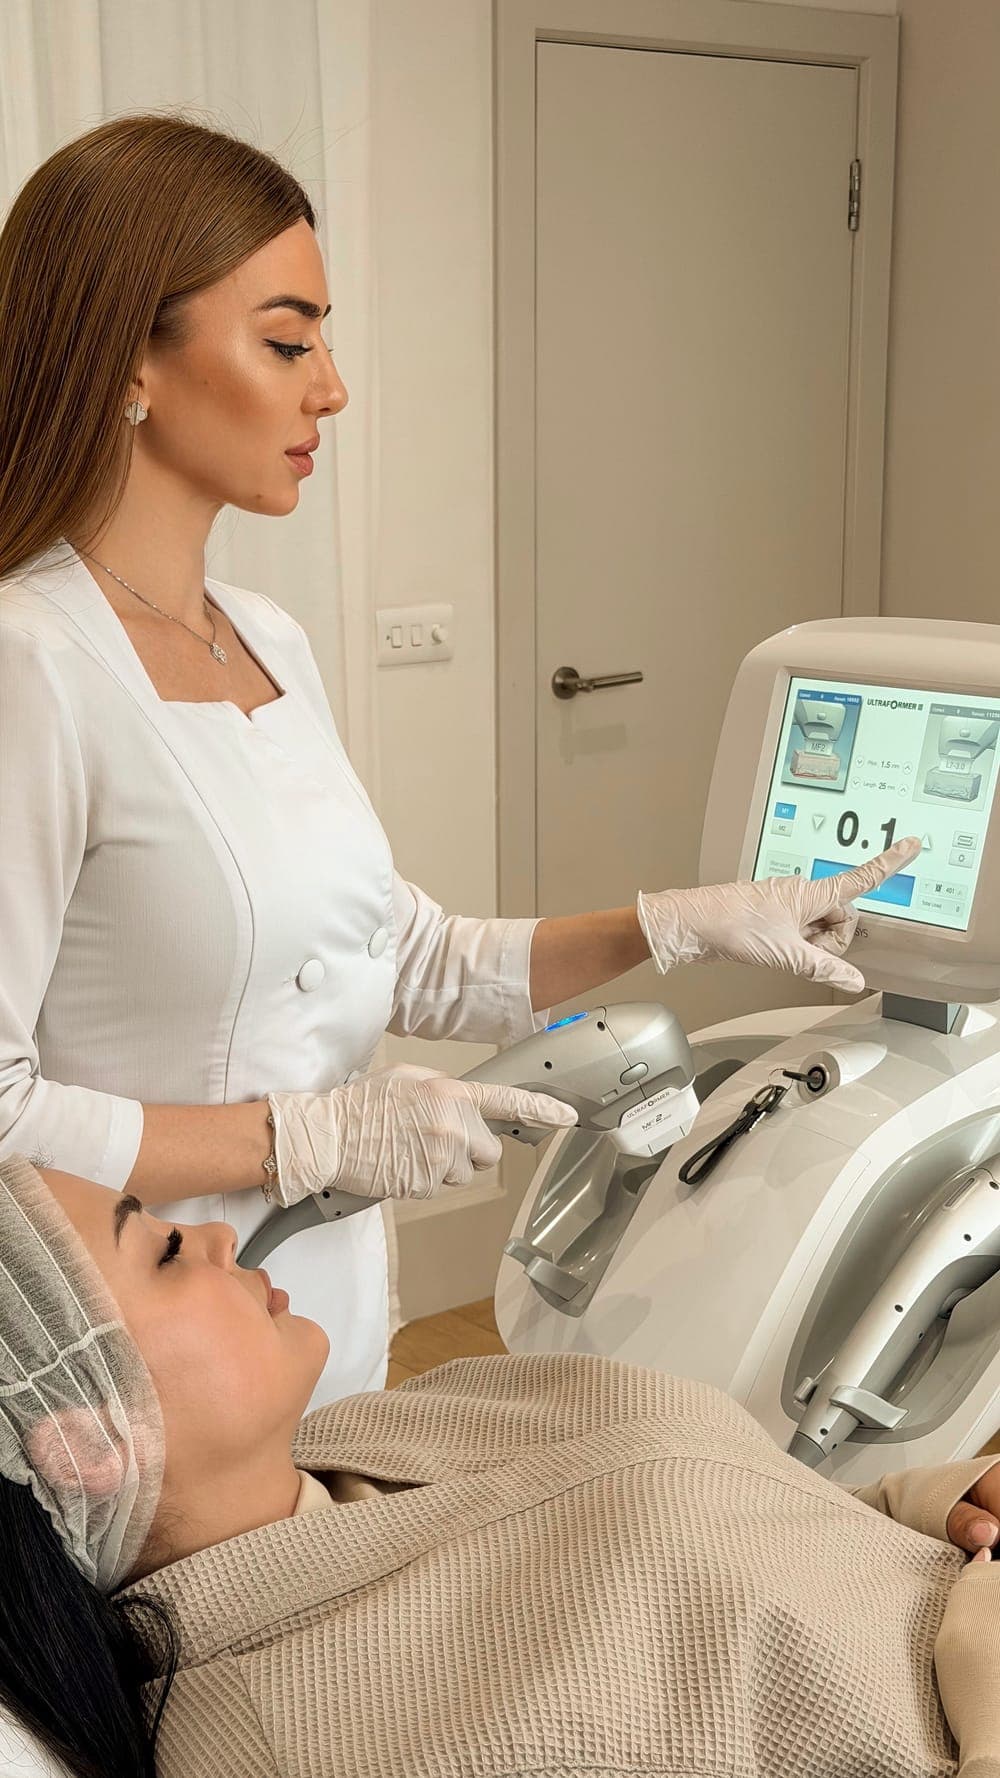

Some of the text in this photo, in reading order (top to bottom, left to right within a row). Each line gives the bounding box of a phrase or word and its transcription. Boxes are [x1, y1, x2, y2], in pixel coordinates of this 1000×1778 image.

[867, 698, 917, 710] ULTRAFORMER
[811, 743, 826, 753] MF2
[880, 760, 891, 769] 1.5
[878, 782, 887, 790] 25
[836, 810, 897, 852] 0.1
